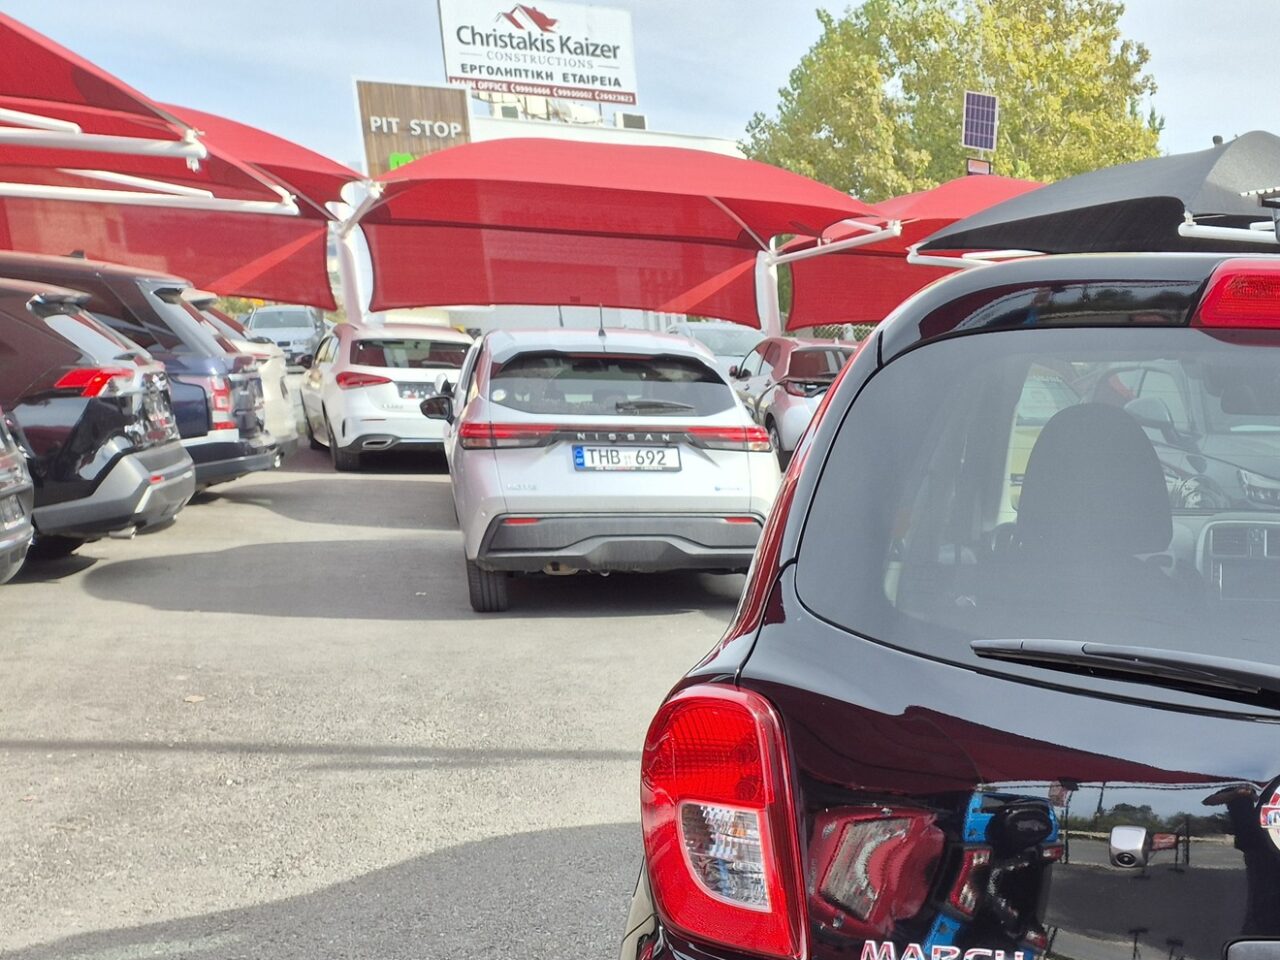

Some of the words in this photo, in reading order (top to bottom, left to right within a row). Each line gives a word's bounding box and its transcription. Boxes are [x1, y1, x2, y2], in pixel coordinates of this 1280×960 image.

[456, 25, 556, 53] Christakis
[560, 35, 620, 59] Kaizer
[486, 51, 594, 69] CONSTRUCTIONS
[461, 63, 554, 81] ΕΡΓΟΛΗΠΤΙΚΗ
[562, 72, 622, 88] ΕΤΑΙΡΕΙΑ
[477, 81, 508, 92] OFFICE
[370, 116, 400, 135] PIT
[411, 119, 462, 138] STOP
[577, 432, 670, 441] NISSAN
[586, 448, 621, 465] THB
[635, 449, 667, 466] 692
